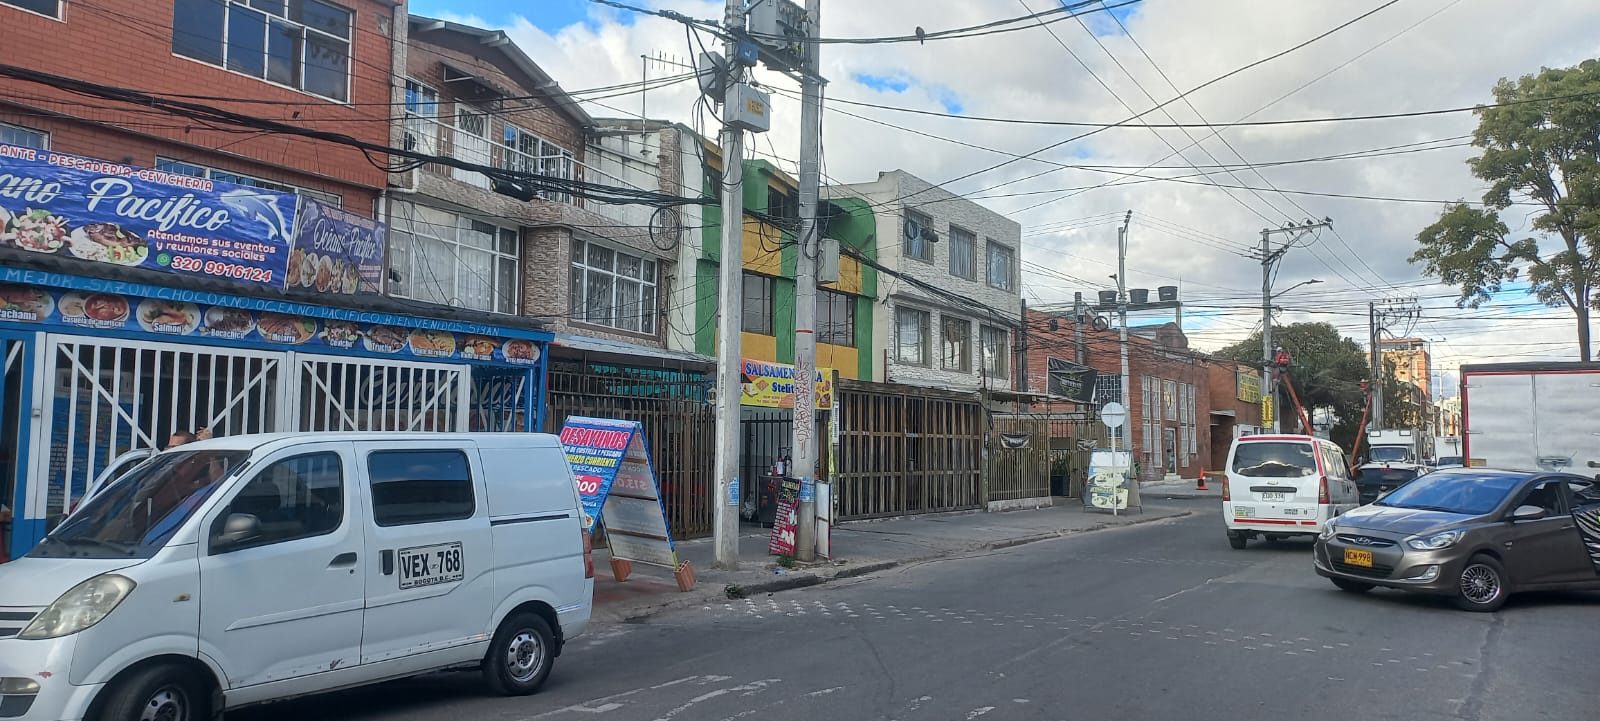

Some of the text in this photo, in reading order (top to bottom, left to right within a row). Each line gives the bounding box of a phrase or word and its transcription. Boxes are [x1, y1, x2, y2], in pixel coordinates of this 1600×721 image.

[148, 230, 276, 253] Atendemos sus eventos
[156, 241, 265, 262] y reuniones sociales
[171, 256, 272, 282] 320 9916124
[0, 309, 37, 320] achama
[255, 299, 315, 318] OCEANO
[321, 307, 380, 323] PACIFICO
[153, 322, 182, 333] Salmon
[560, 425, 631, 450] DESAYUNOS
[401, 549, 460, 579] VEX 768
